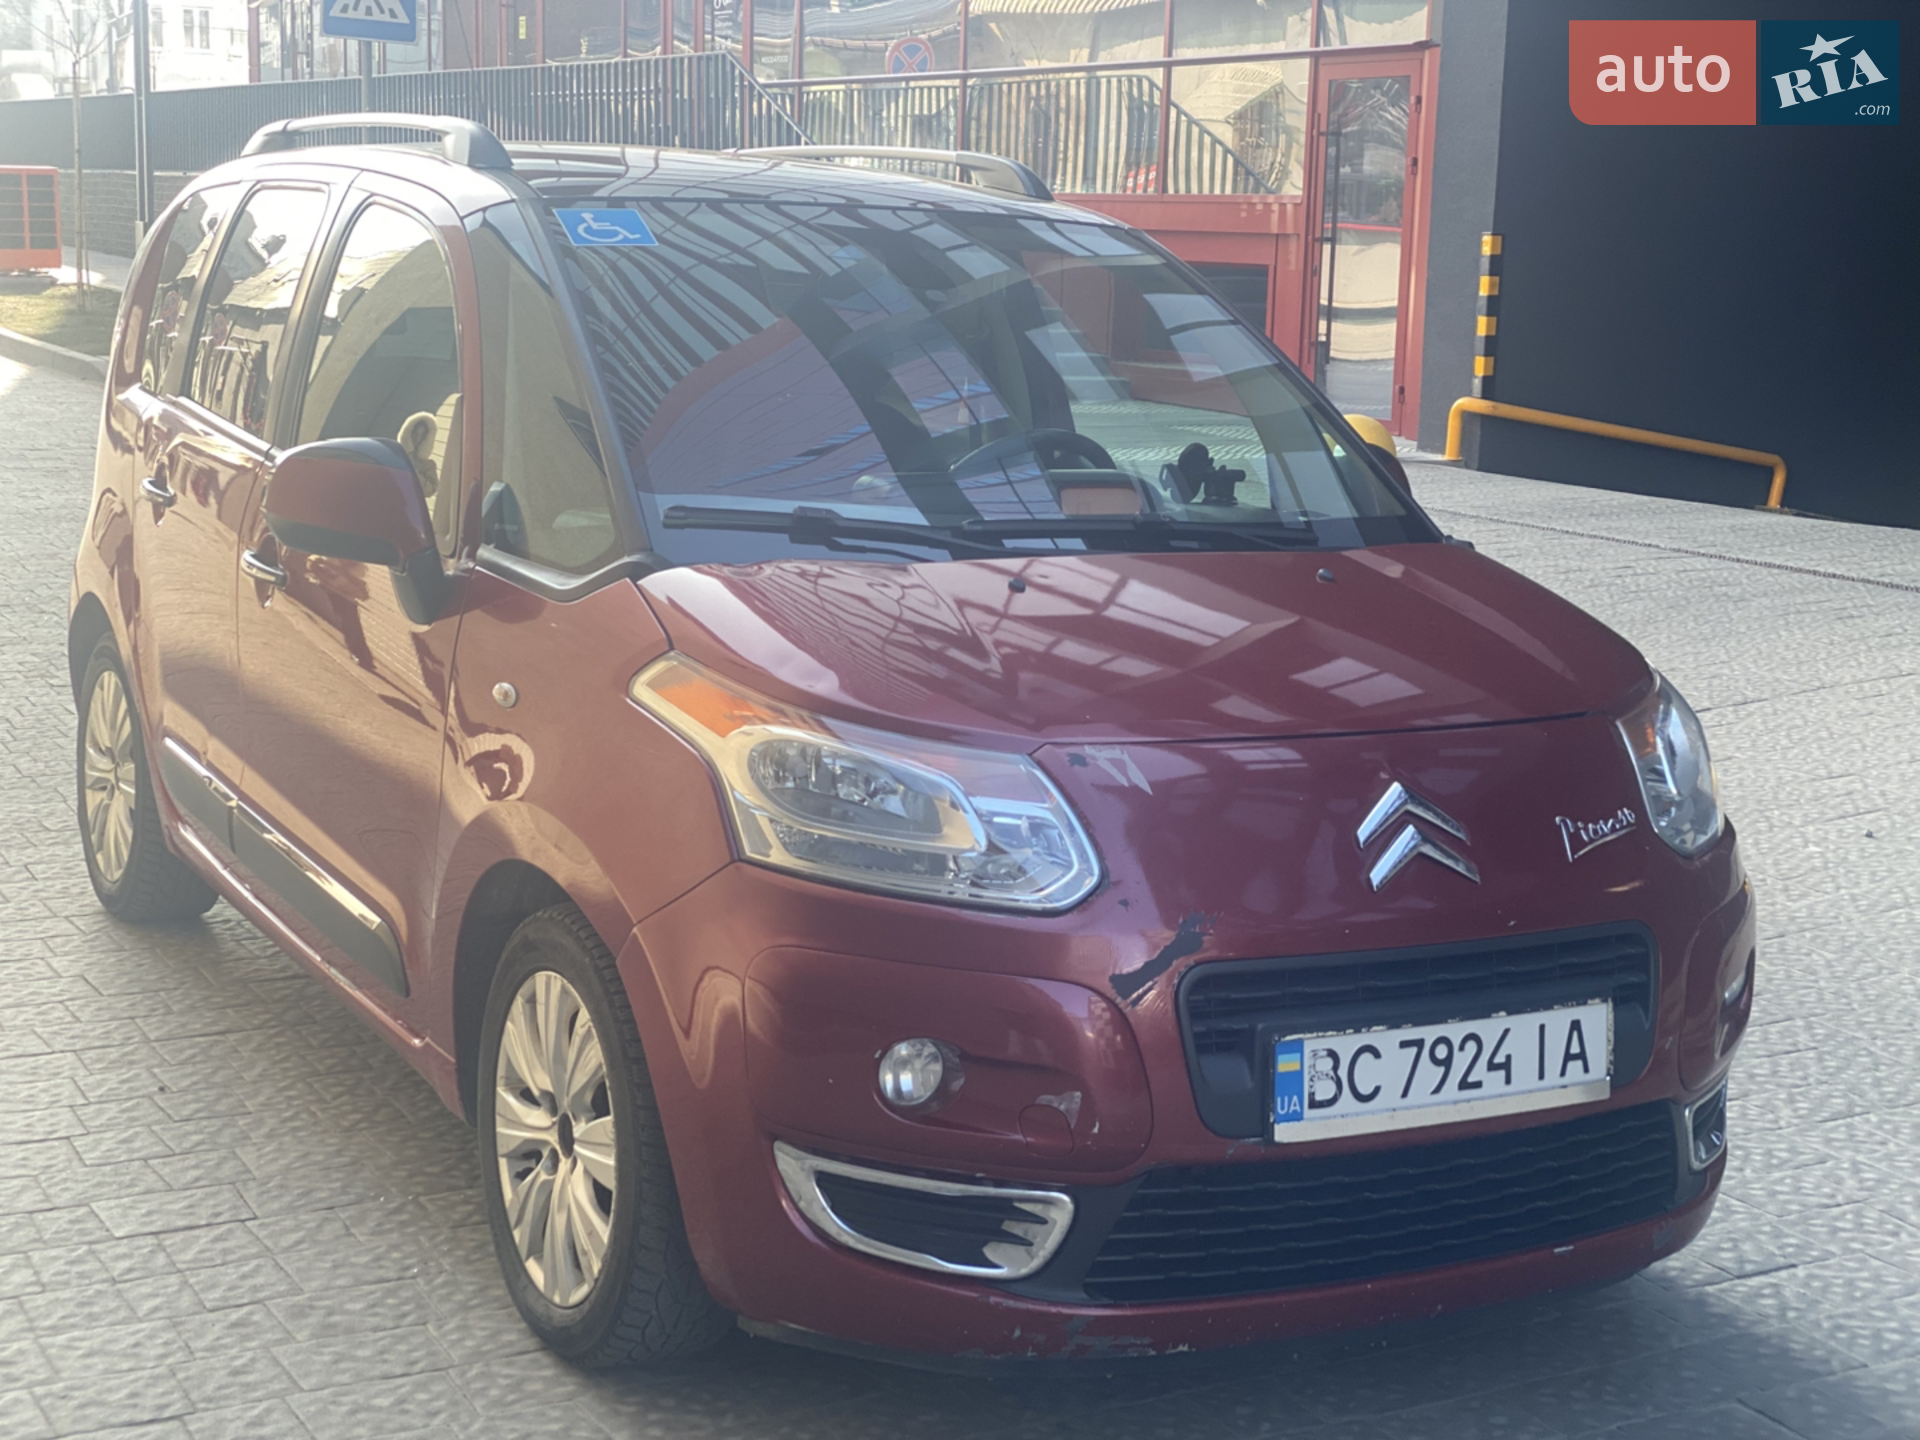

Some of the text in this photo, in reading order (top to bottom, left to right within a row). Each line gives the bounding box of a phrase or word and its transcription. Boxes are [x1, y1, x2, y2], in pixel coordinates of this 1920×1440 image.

[1307, 1018, 1591, 1110] BC 7924 IA
[1277, 1095, 1301, 1115] UA
